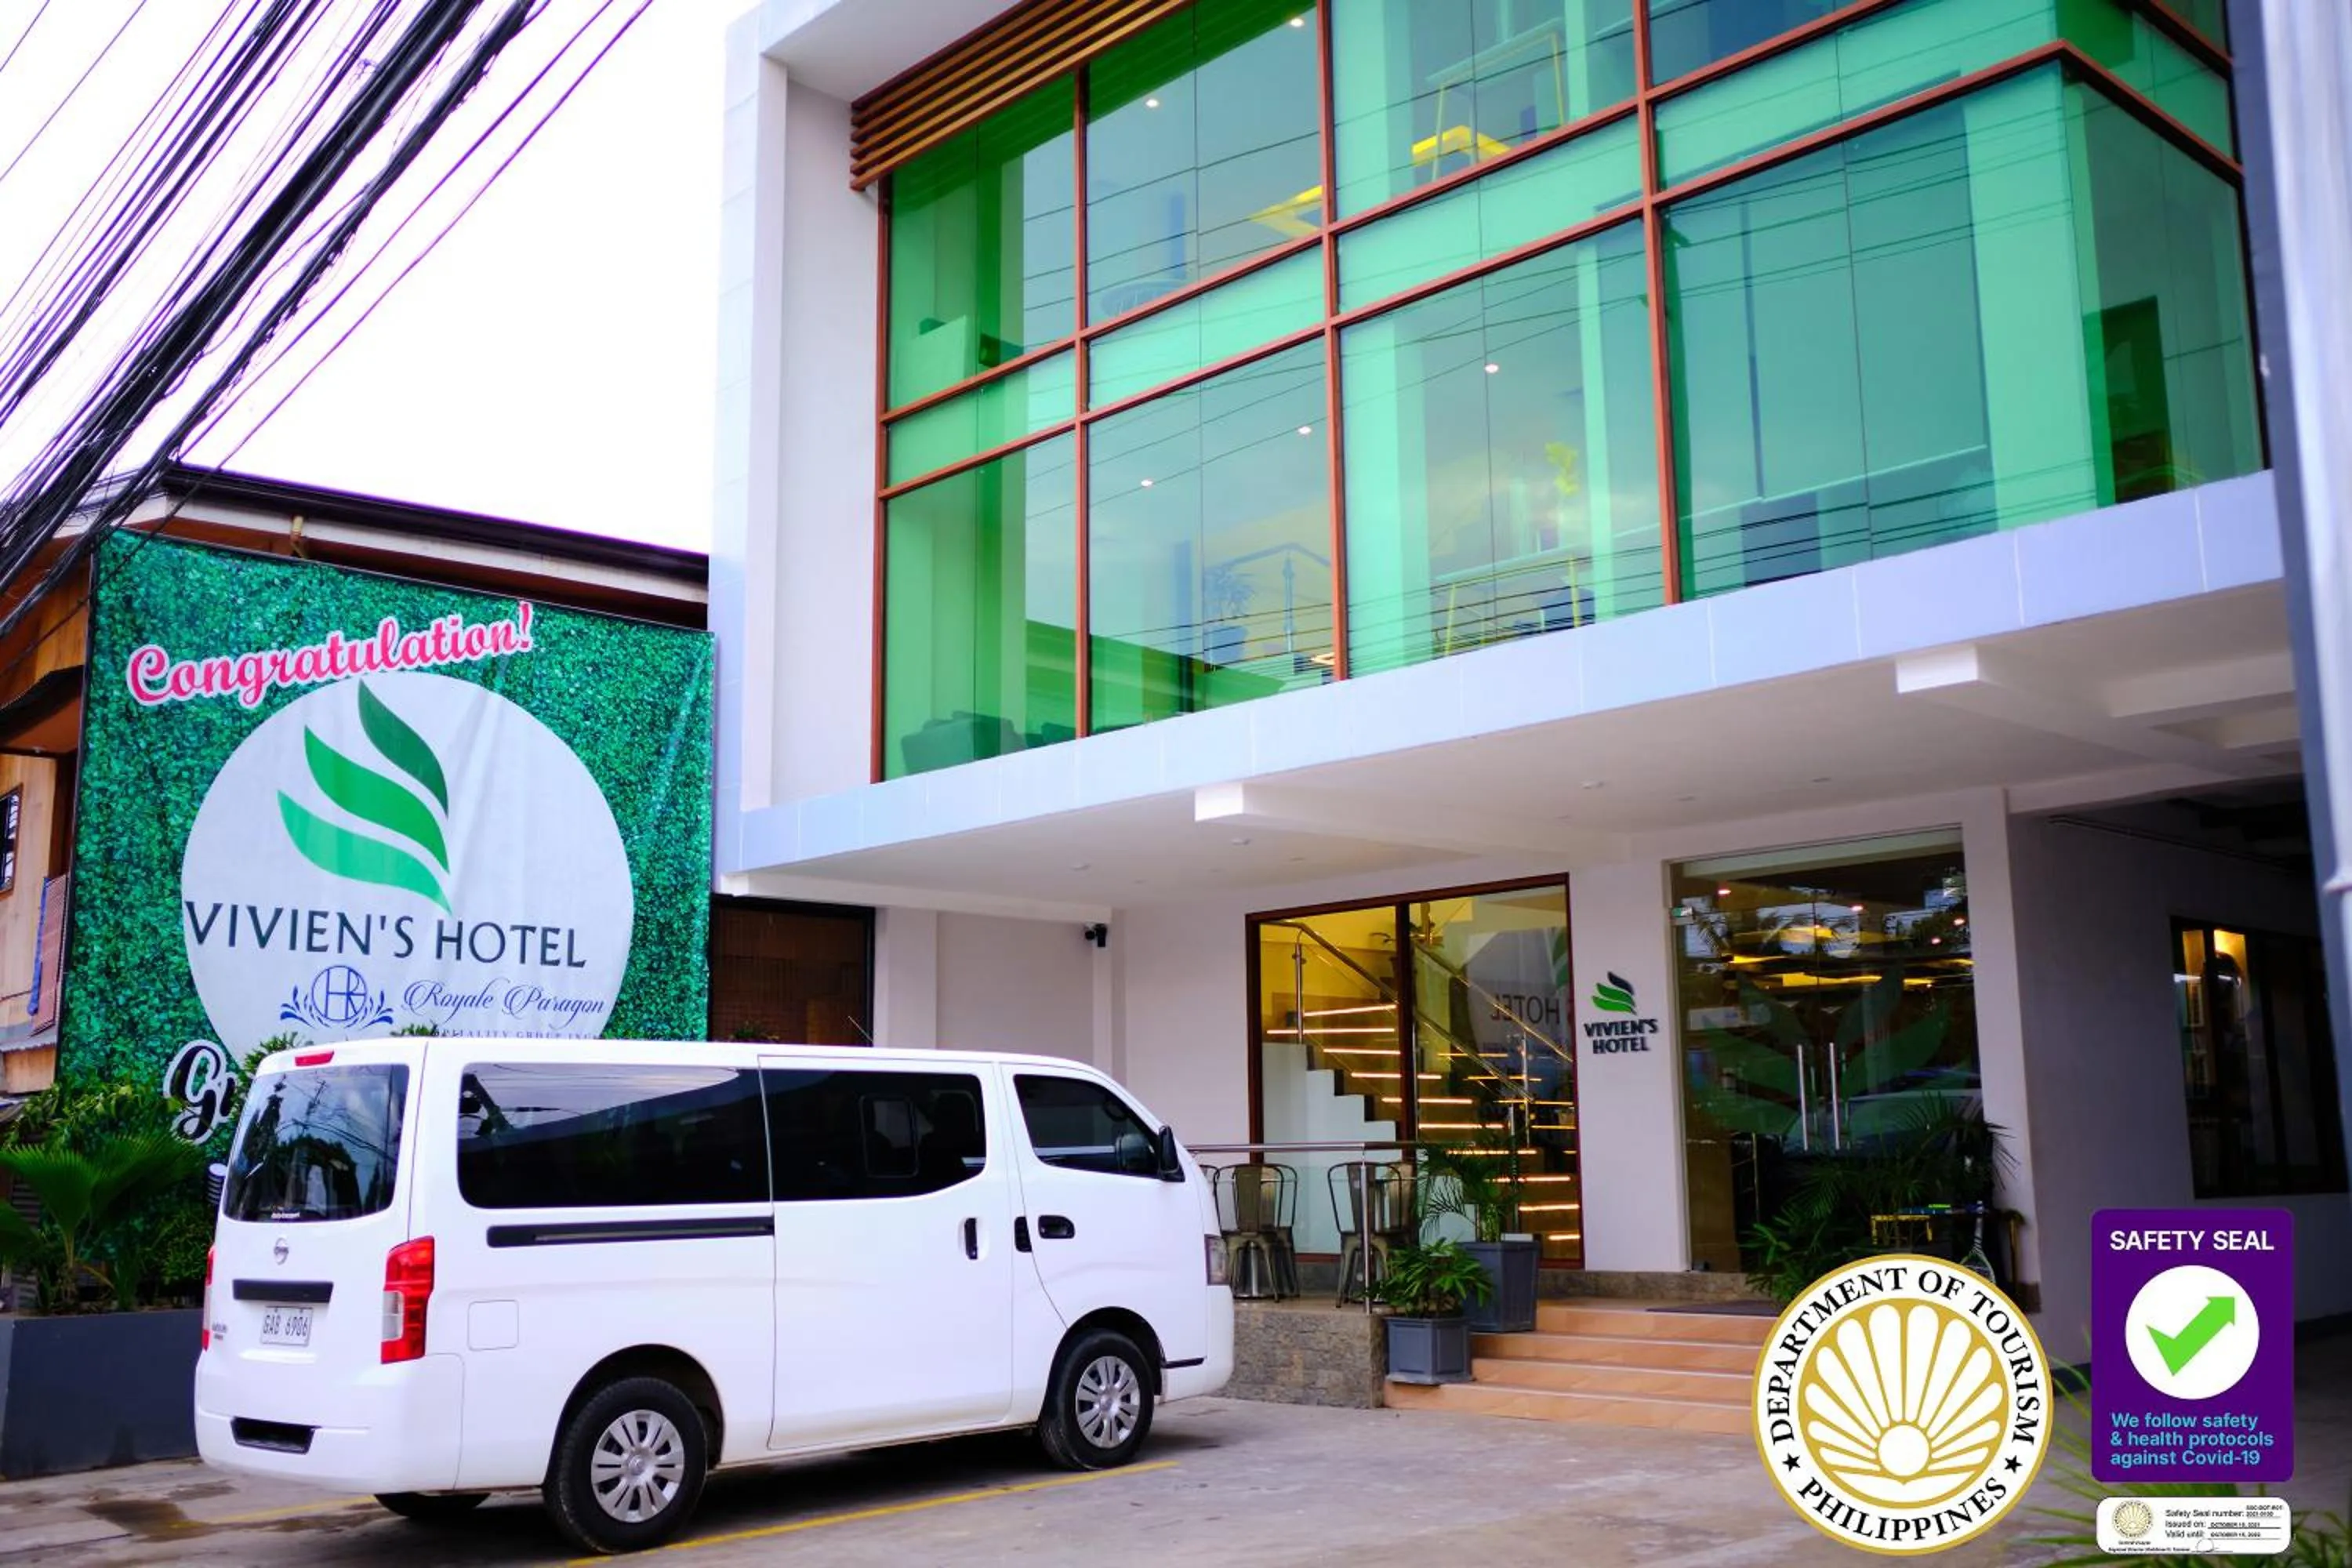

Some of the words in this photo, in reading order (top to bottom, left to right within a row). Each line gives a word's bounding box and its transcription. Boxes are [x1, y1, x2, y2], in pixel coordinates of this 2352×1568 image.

[129, 602, 532, 706] Congratulation!
[185, 901, 414, 958] VIVIEN'S
[436, 919, 586, 968] HOTEL
[401, 978, 510, 1023] Royale
[502, 984, 604, 1030] Paragon
[1583, 1018, 1659, 1037] VIVIEN'S
[1592, 1038, 1650, 1054] HOTEL
